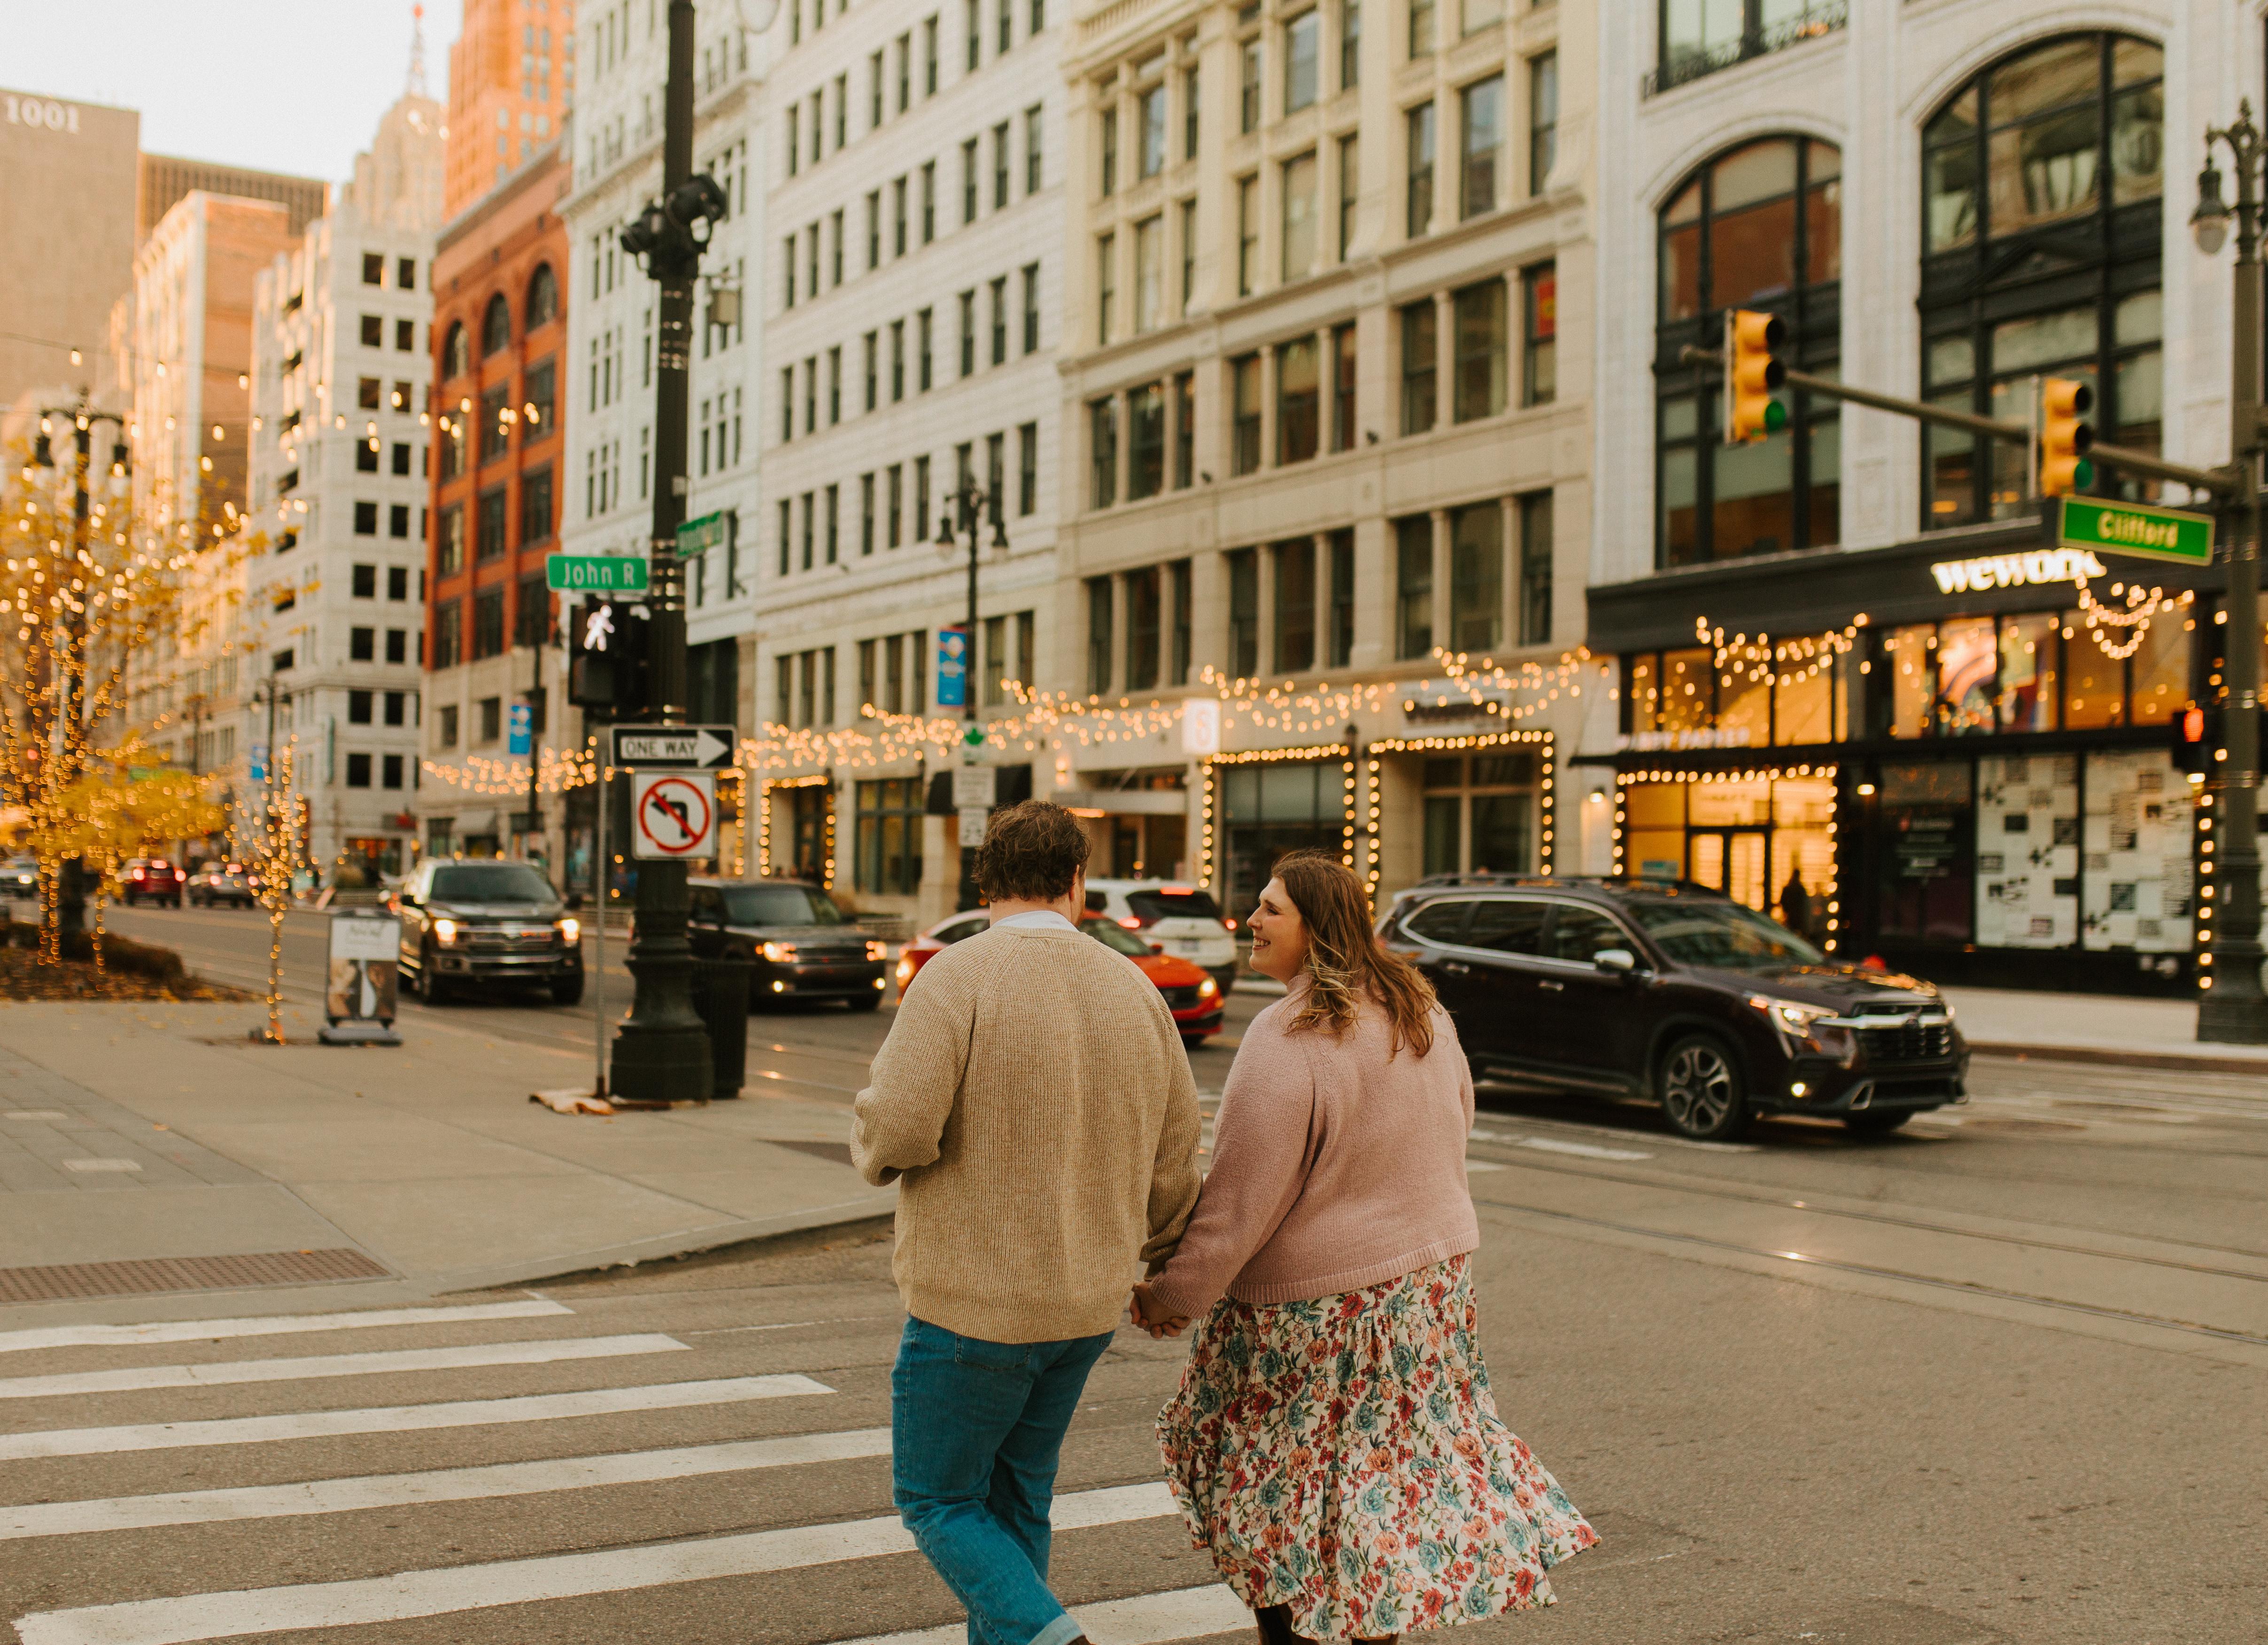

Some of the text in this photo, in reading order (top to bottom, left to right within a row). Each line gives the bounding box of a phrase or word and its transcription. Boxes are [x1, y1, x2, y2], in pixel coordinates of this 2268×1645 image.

[7, 97, 80, 134] 1001
[2098, 510, 2179, 548] Clifford
[564, 562, 634, 586] John R
[625, 741, 697, 756] ONE WAY
